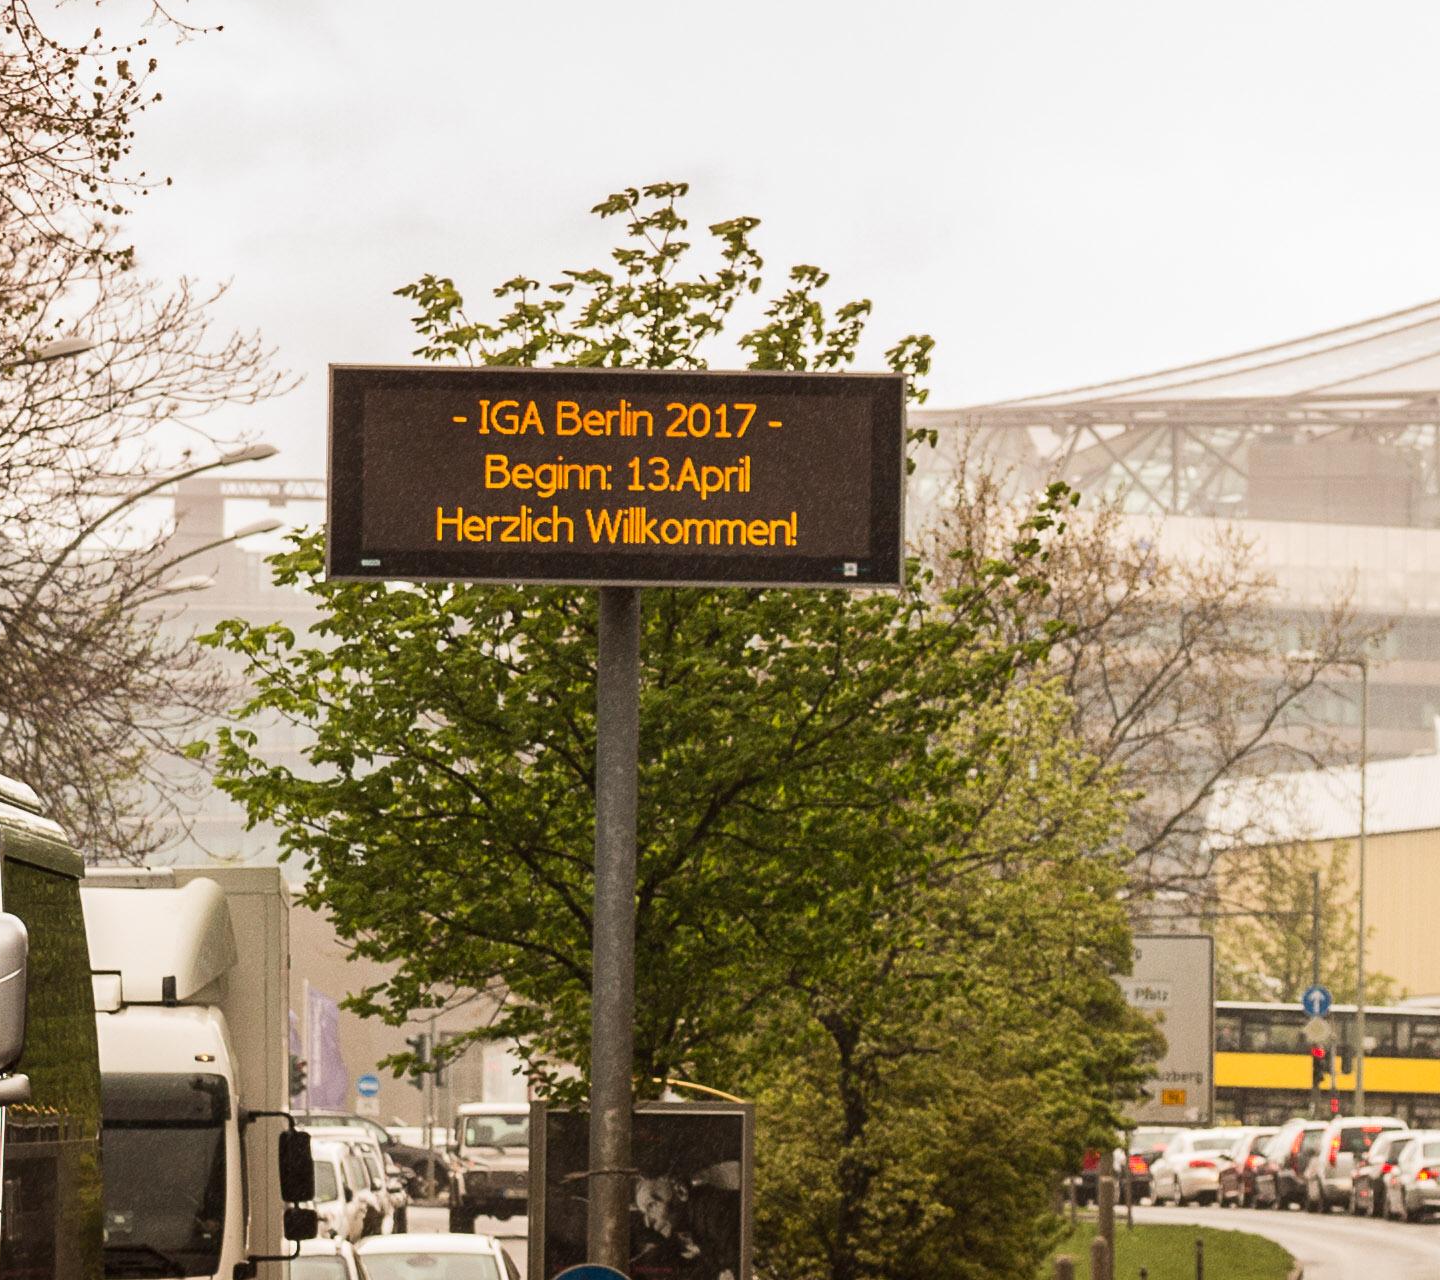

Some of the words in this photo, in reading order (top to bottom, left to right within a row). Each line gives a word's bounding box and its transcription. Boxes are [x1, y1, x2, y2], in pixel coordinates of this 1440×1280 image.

[479, 400, 545, 435] IGA
[556, 399, 653, 436] Berlin
[666, 403, 757, 438] 2017
[485, 454, 613, 498] Beginn:
[627, 455, 751, 500] 13.April
[436, 505, 575, 543] Herzlich
[585, 508, 798, 546] Willkommen!
